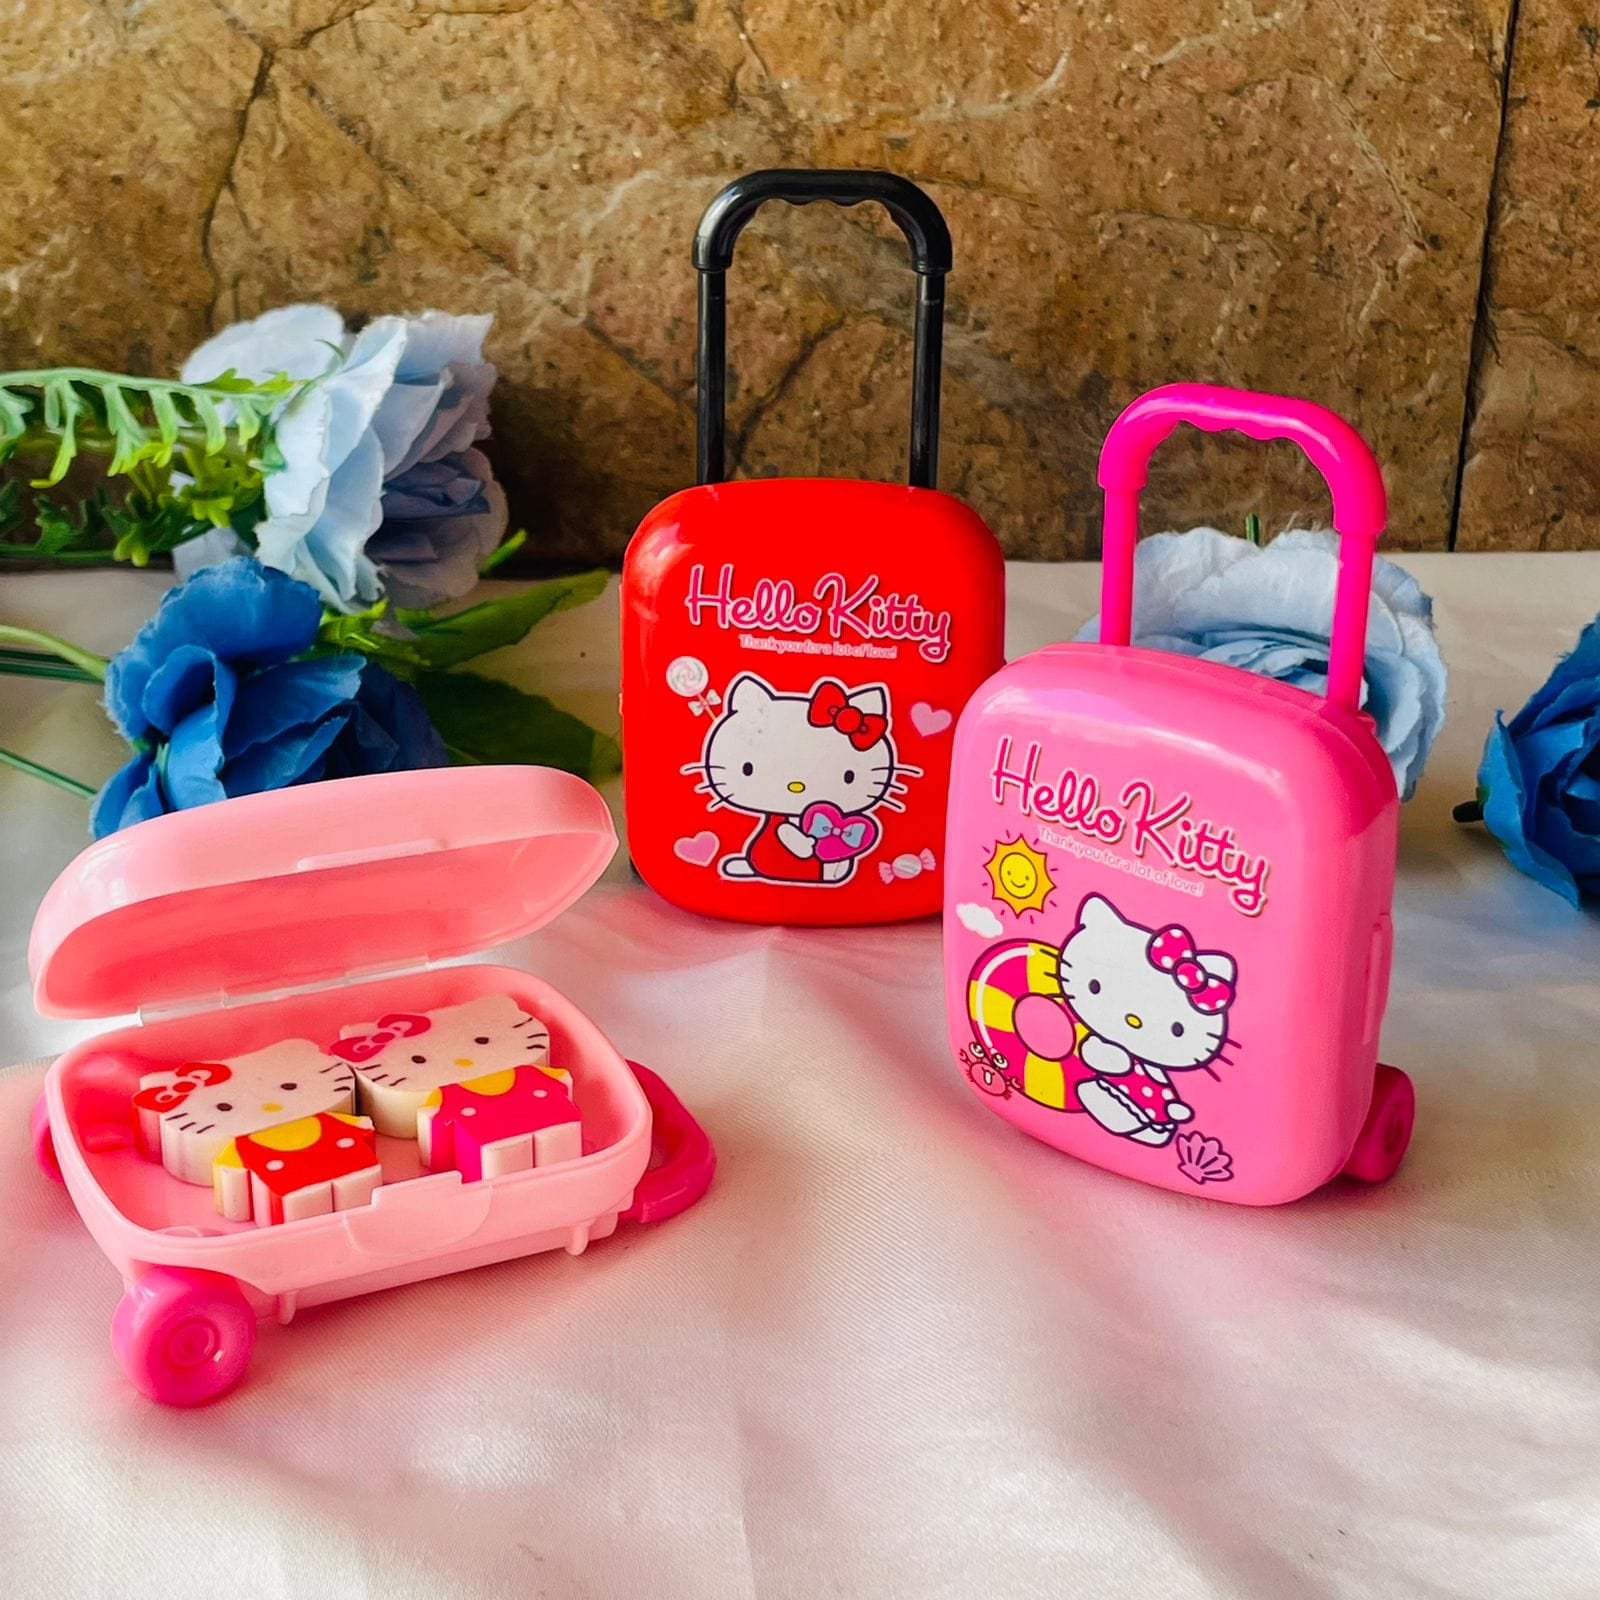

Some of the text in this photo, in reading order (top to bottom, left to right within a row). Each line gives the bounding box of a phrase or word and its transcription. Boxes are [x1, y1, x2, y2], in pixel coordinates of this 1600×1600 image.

[685, 564, 951, 663] Hello Kitty
[990, 735, 1270, 917] Hello Kitty
[1039, 825, 1074, 849] Thank
[1075, 843, 1101, 861] you
[1103, 849, 1121, 868] for
[1134, 863, 1152, 878] lot
[1153, 869, 1168, 884] of
[1170, 873, 1204, 897] love!
